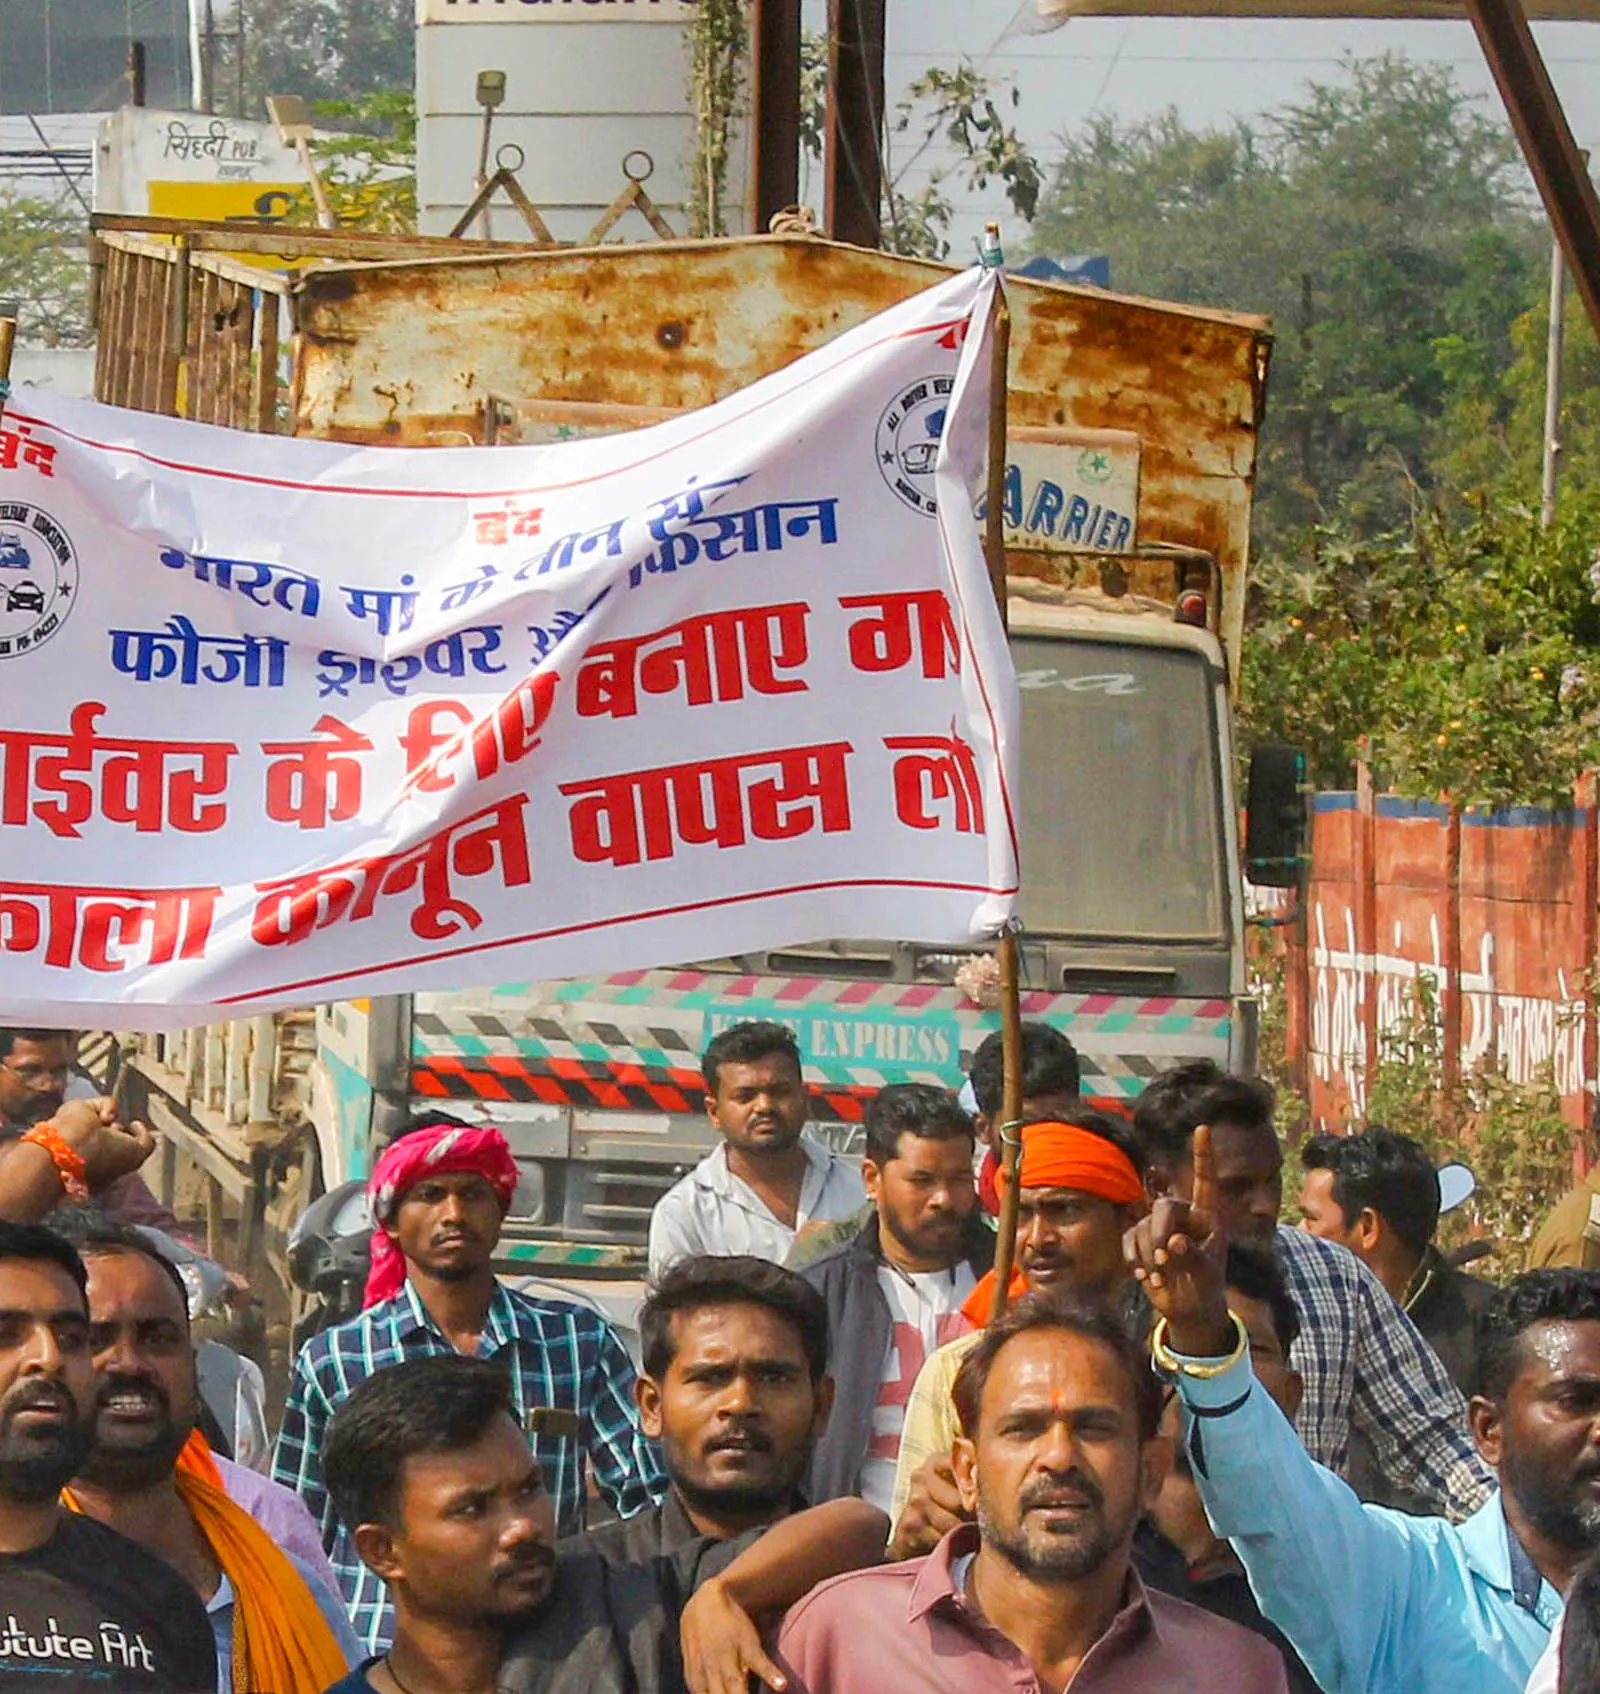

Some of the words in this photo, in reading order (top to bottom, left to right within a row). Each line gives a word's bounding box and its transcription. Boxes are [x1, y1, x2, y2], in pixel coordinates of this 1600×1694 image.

[110, 616, 288, 687] फौजी
[261, 715, 374, 830] के
[575, 600, 813, 719] बनाए
[251, 794, 532, 942] कानून
[558, 741, 855, 868] वापस
[812, 1019, 949, 1064] EXPRESS
[98, 1622, 155, 1672] Art
